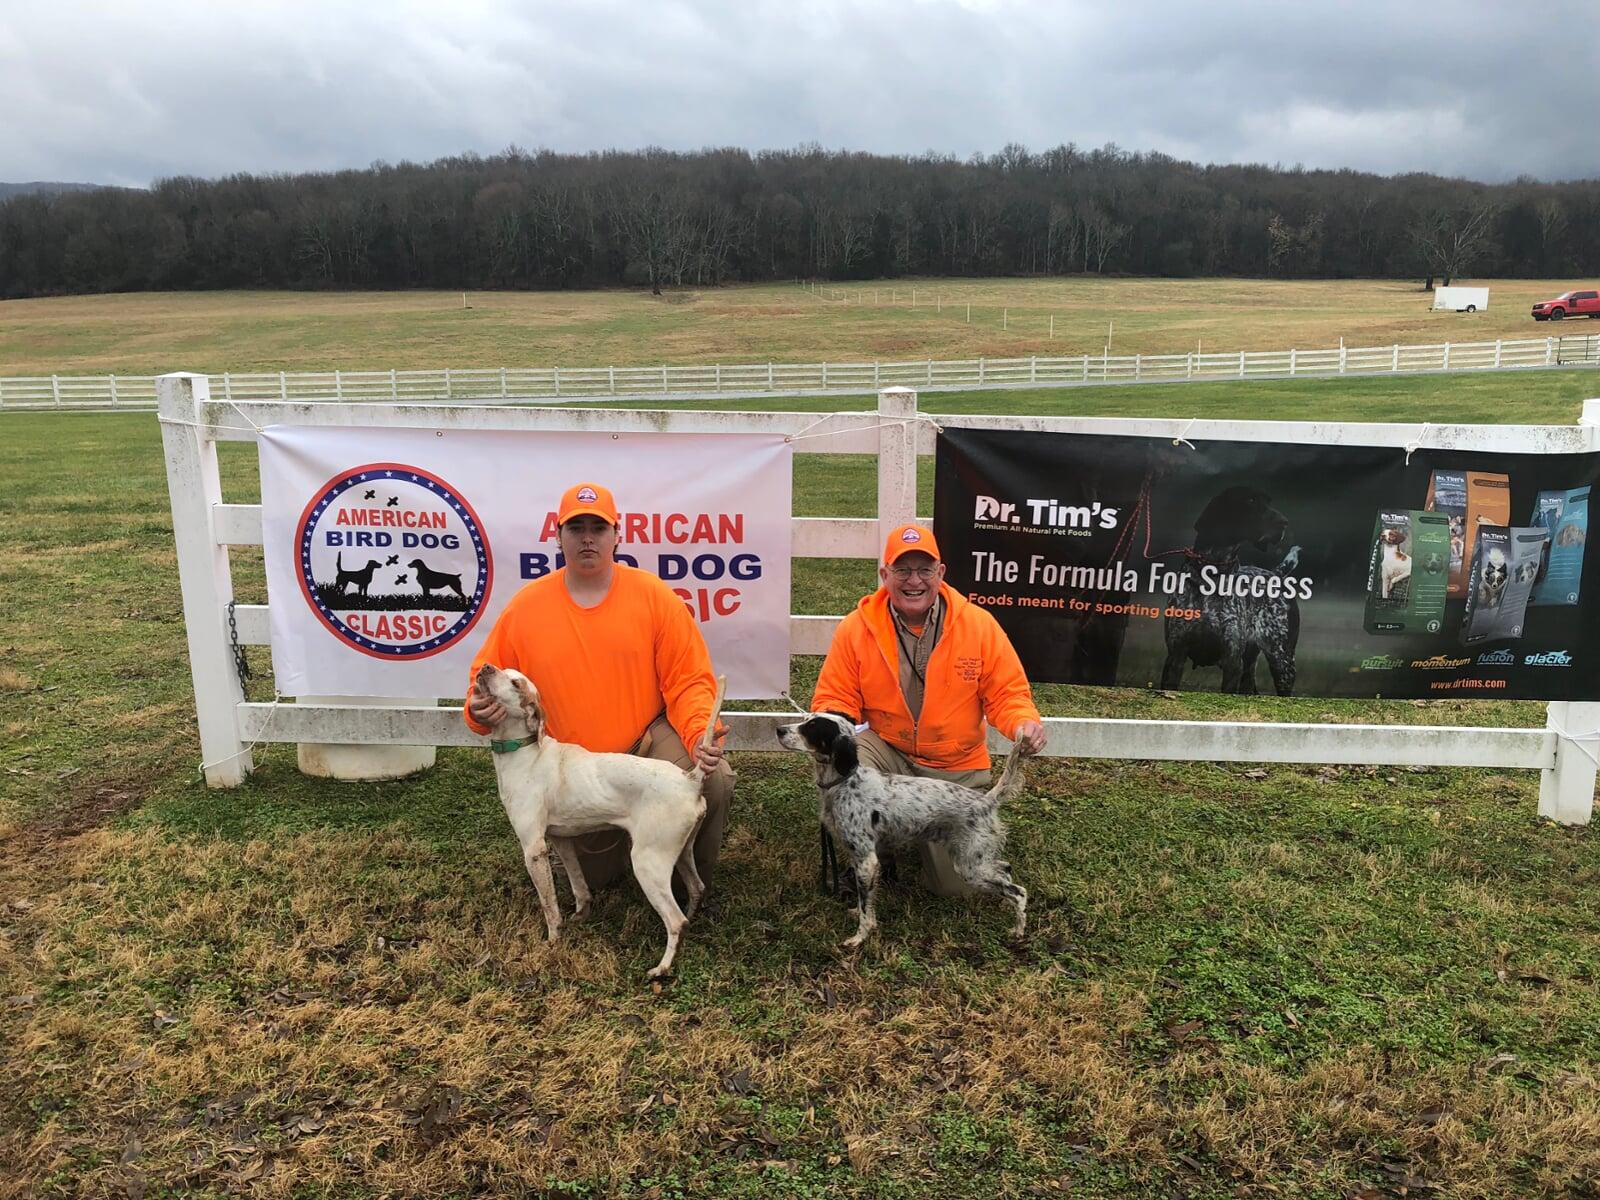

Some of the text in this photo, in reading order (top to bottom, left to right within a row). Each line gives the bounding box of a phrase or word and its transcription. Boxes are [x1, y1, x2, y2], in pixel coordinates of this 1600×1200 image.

[336, 508, 447, 529] AMERICAN
[975, 495, 1118, 529] Dr. Tim's
[539, 512, 744, 544] ARICAN
[974, 522, 1008, 531] Premium
[1022, 527, 1051, 535] Natural
[1053, 528, 1066, 536] Pet
[1068, 529, 1092, 537] Foods
[326, 531, 460, 549] BIRD DOG
[658, 553, 762, 581] DOG
[971, 551, 1314, 600] The Formula For Success
[967, 592, 1201, 620] Foods meant for sporting dogs
[346, 614, 446, 641] CLASSIC
[1411, 657, 1471, 668] momentum
[1477, 653, 1515, 663] fusion
[1524, 653, 1572, 665] glacier
[1431, 678, 1506, 690] www.drtims.com
